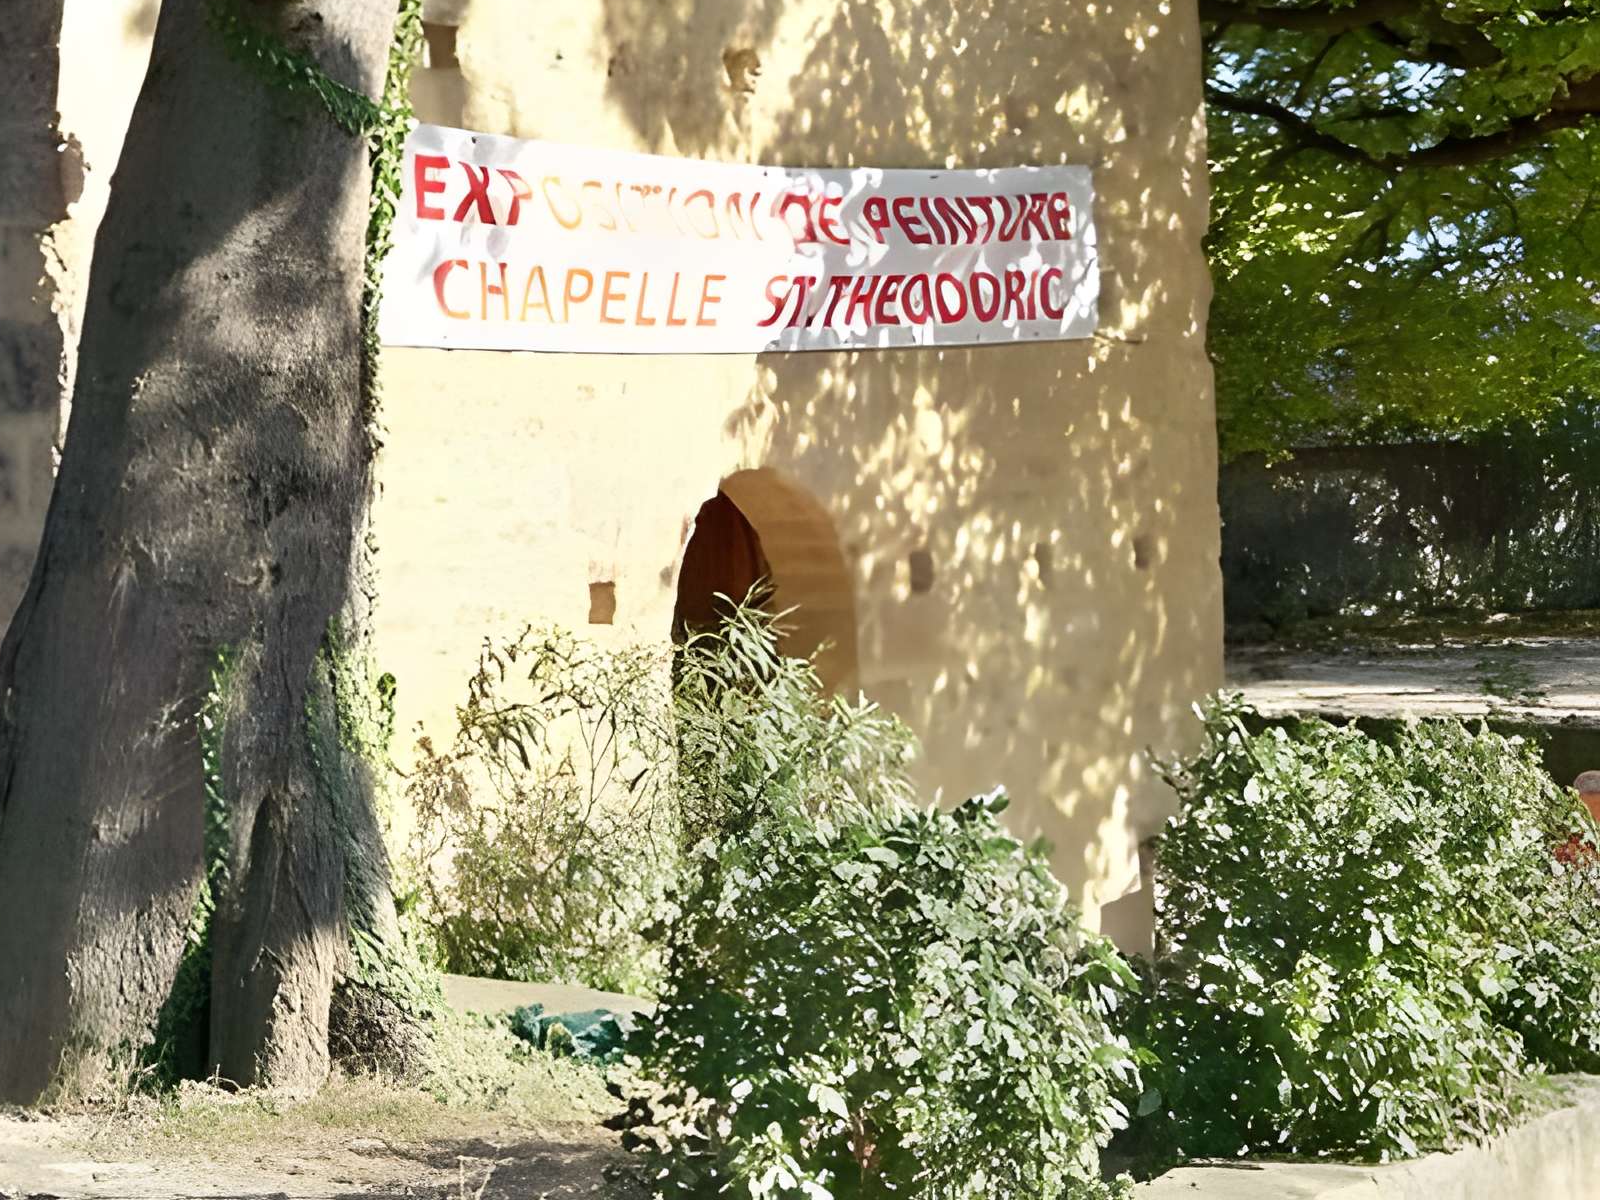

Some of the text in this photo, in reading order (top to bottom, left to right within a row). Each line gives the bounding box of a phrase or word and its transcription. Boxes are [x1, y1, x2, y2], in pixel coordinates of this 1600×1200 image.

[771, 192, 851, 246] DE
[862, 191, 1073, 246] PEINTURE
[432, 258, 728, 326] CHAPELLE
